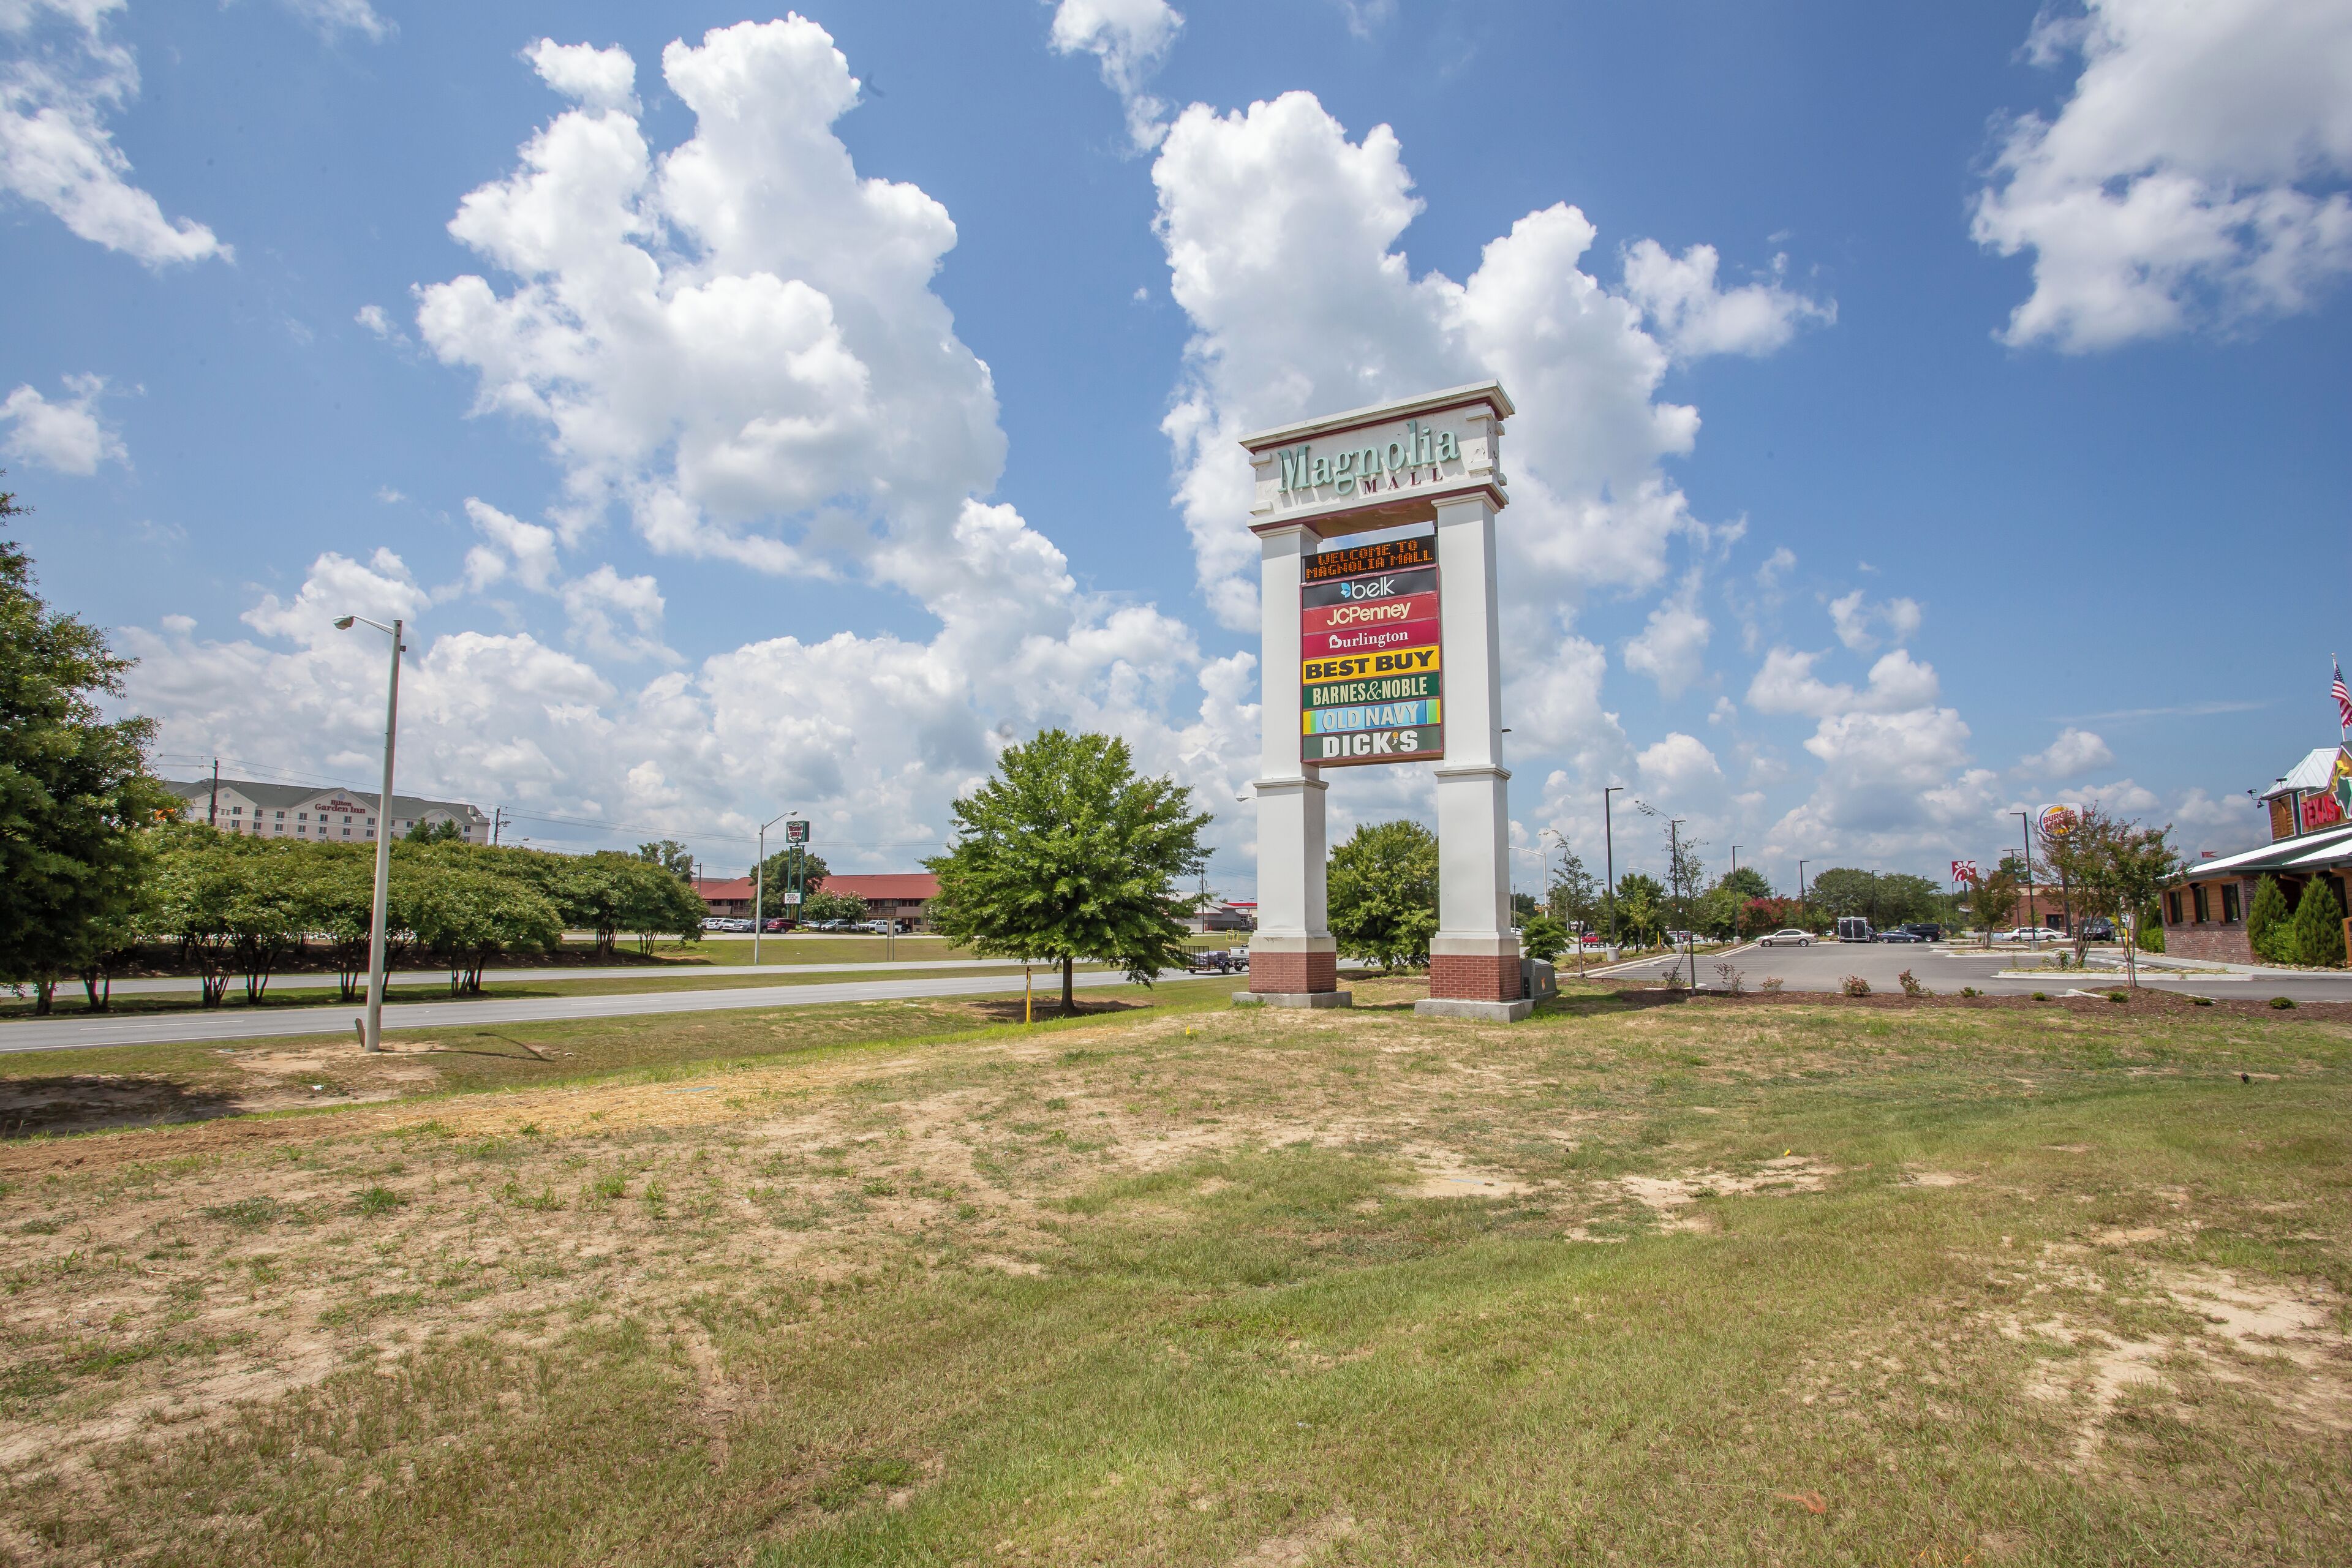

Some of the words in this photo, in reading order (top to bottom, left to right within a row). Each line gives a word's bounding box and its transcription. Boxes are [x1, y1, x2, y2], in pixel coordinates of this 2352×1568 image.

[1277, 419, 1460, 496] Magnolia
[1363, 467, 1444, 494] MALL
[1306, 557, 1384, 579] MAGNOLIA
[1390, 549, 1433, 566] MALL
[1318, 544, 1391, 565] WELCOME
[1396, 540, 1417, 552] TO
[1352, 576, 1395, 599] belk
[1327, 602, 1411, 626] JCPenney
[1329, 630, 1409, 649] Burlington
[1305, 658, 1370, 679] BEST
[1376, 650, 1435, 672] BUY
[1322, 710, 1360, 730] OLD
[1365, 703, 1419, 726] NAVY
[1322, 730, 1418, 758] DICK'S
[315, 803, 348, 812] Garden
[2043, 810, 2075, 824] BURGER
[2301, 794, 2340, 827] TEXAS
